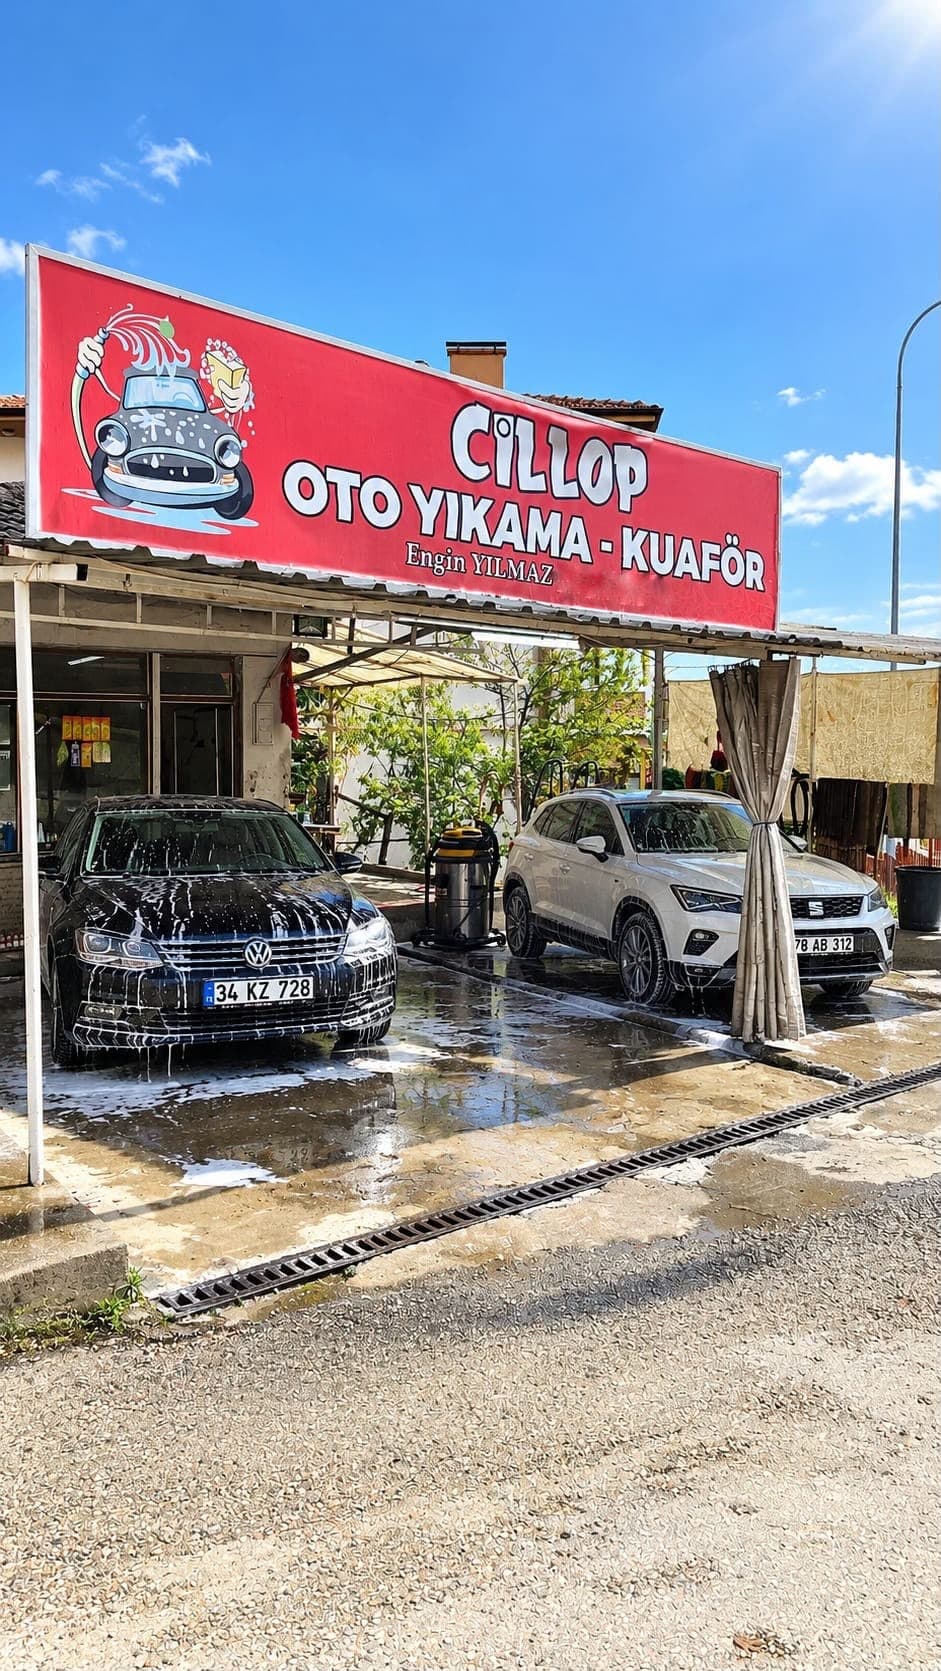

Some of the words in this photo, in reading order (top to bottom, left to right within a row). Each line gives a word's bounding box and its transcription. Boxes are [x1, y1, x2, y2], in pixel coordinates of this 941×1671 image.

[282, 459, 402, 529] OTO
[407, 484, 593, 564] YIKAMA
[621, 525, 766, 592] KUAFÖR
[405, 542, 467, 576] Engin
[471, 552, 554, 585] YILMAZ
[813, 938, 828, 952] AB
[832, 937, 852, 951] 312
[216, 984, 239, 1003] 34
[247, 982, 270, 1001] KZ
[278, 979, 310, 999] 728
